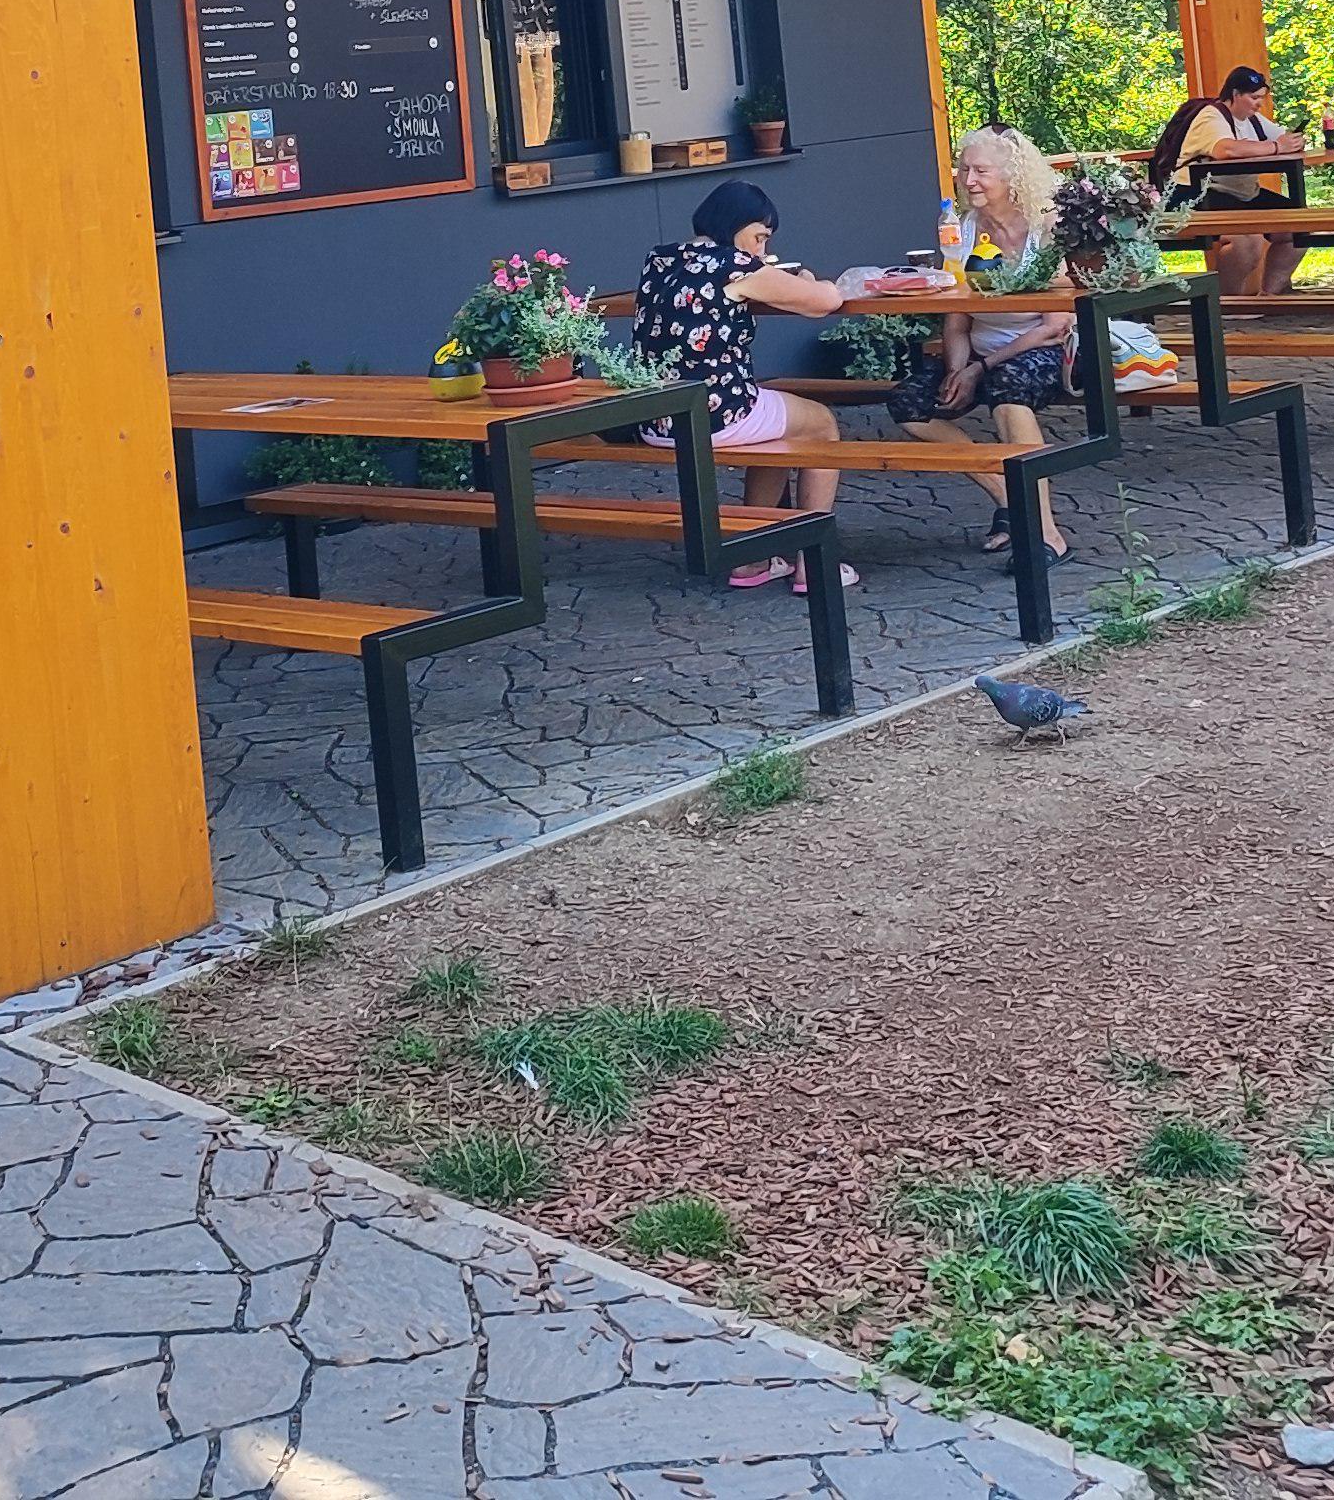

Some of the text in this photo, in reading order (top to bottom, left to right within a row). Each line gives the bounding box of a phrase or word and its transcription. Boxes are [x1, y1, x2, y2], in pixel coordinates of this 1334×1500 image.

[299, 83, 317, 100] DO
[389, 93, 451, 117] JAHODA
[392, 138, 444, 159] JABLKO
